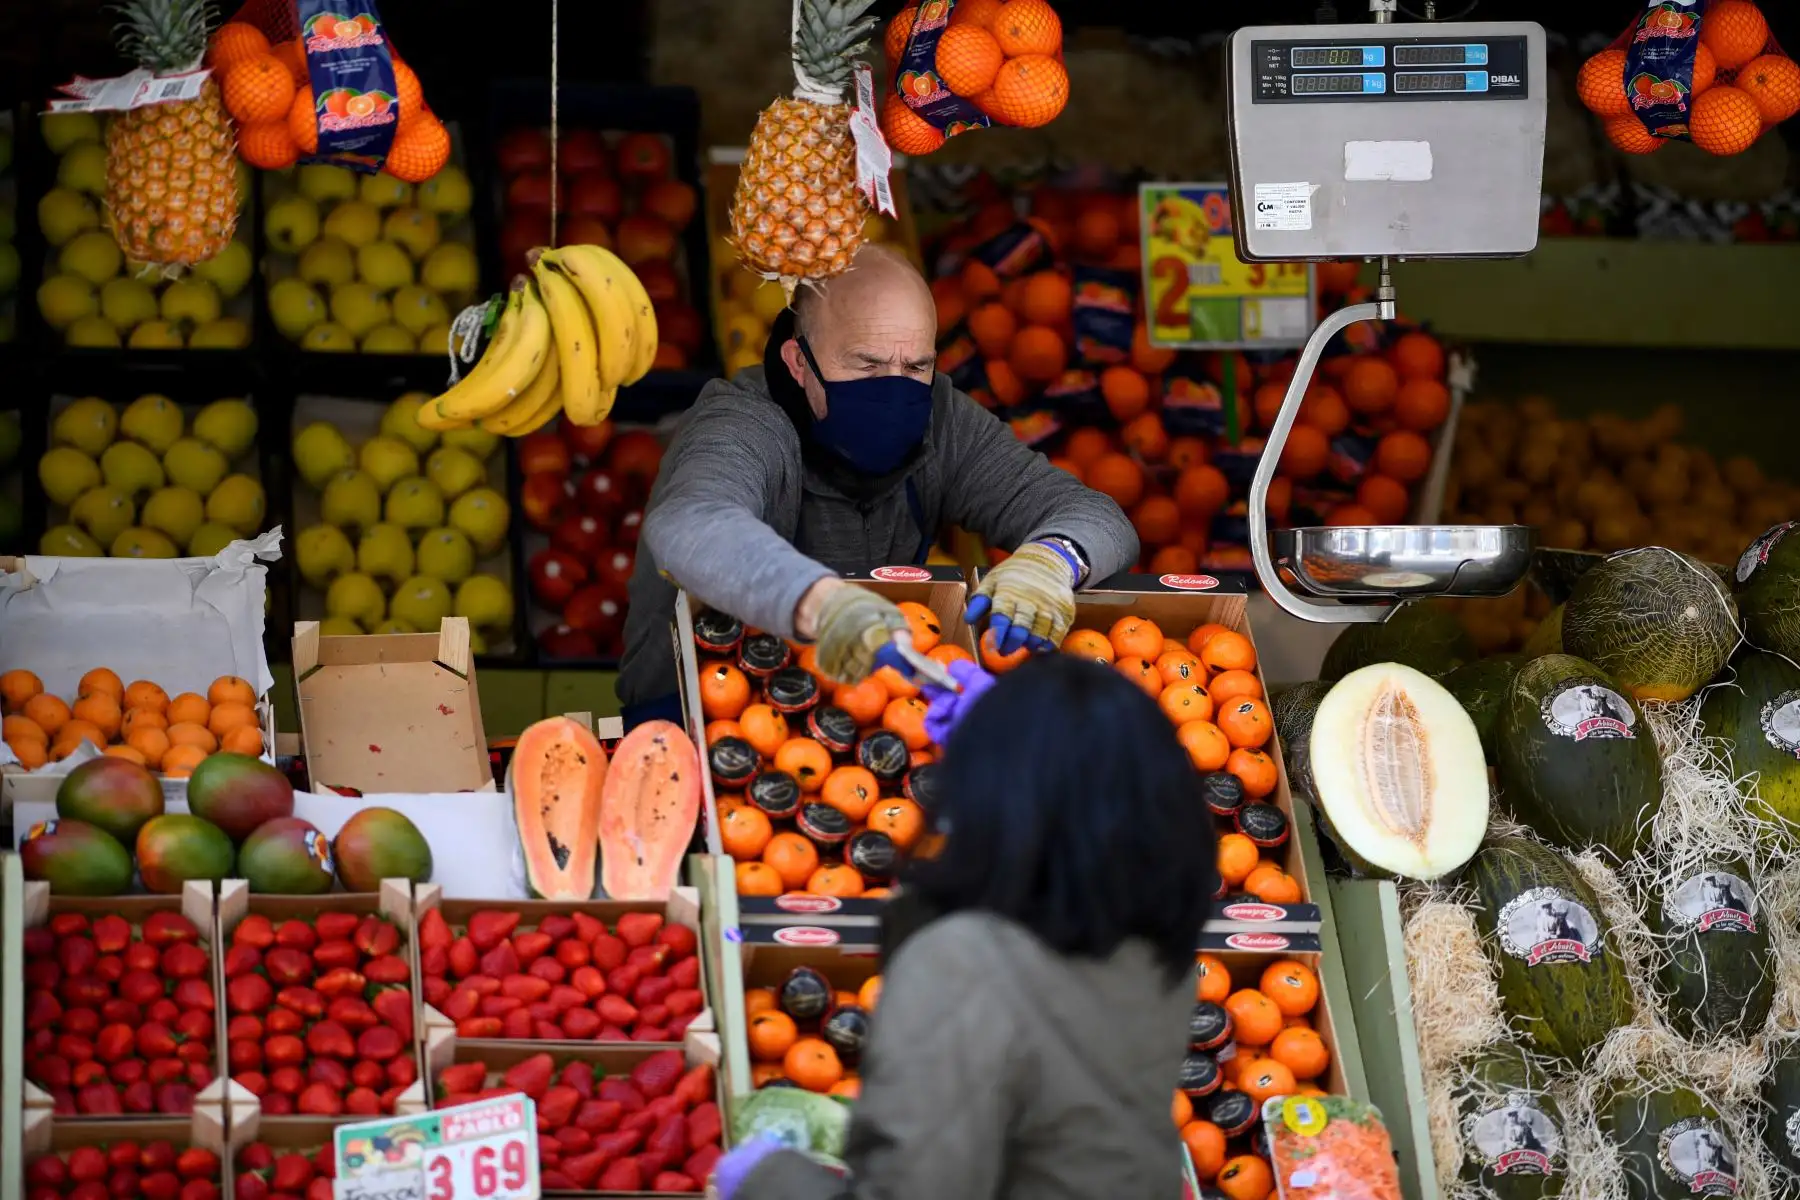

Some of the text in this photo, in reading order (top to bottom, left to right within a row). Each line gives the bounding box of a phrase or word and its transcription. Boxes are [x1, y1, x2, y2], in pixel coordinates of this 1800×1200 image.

[1491, 75, 1520, 83] DIBAL
[1257, 202, 1274, 213] CLM
[1153, 255, 1190, 328] 2
[881, 568, 929, 578] Redondo
[1168, 575, 1215, 585] Redondo
[446, 1111, 521, 1141] PABLO
